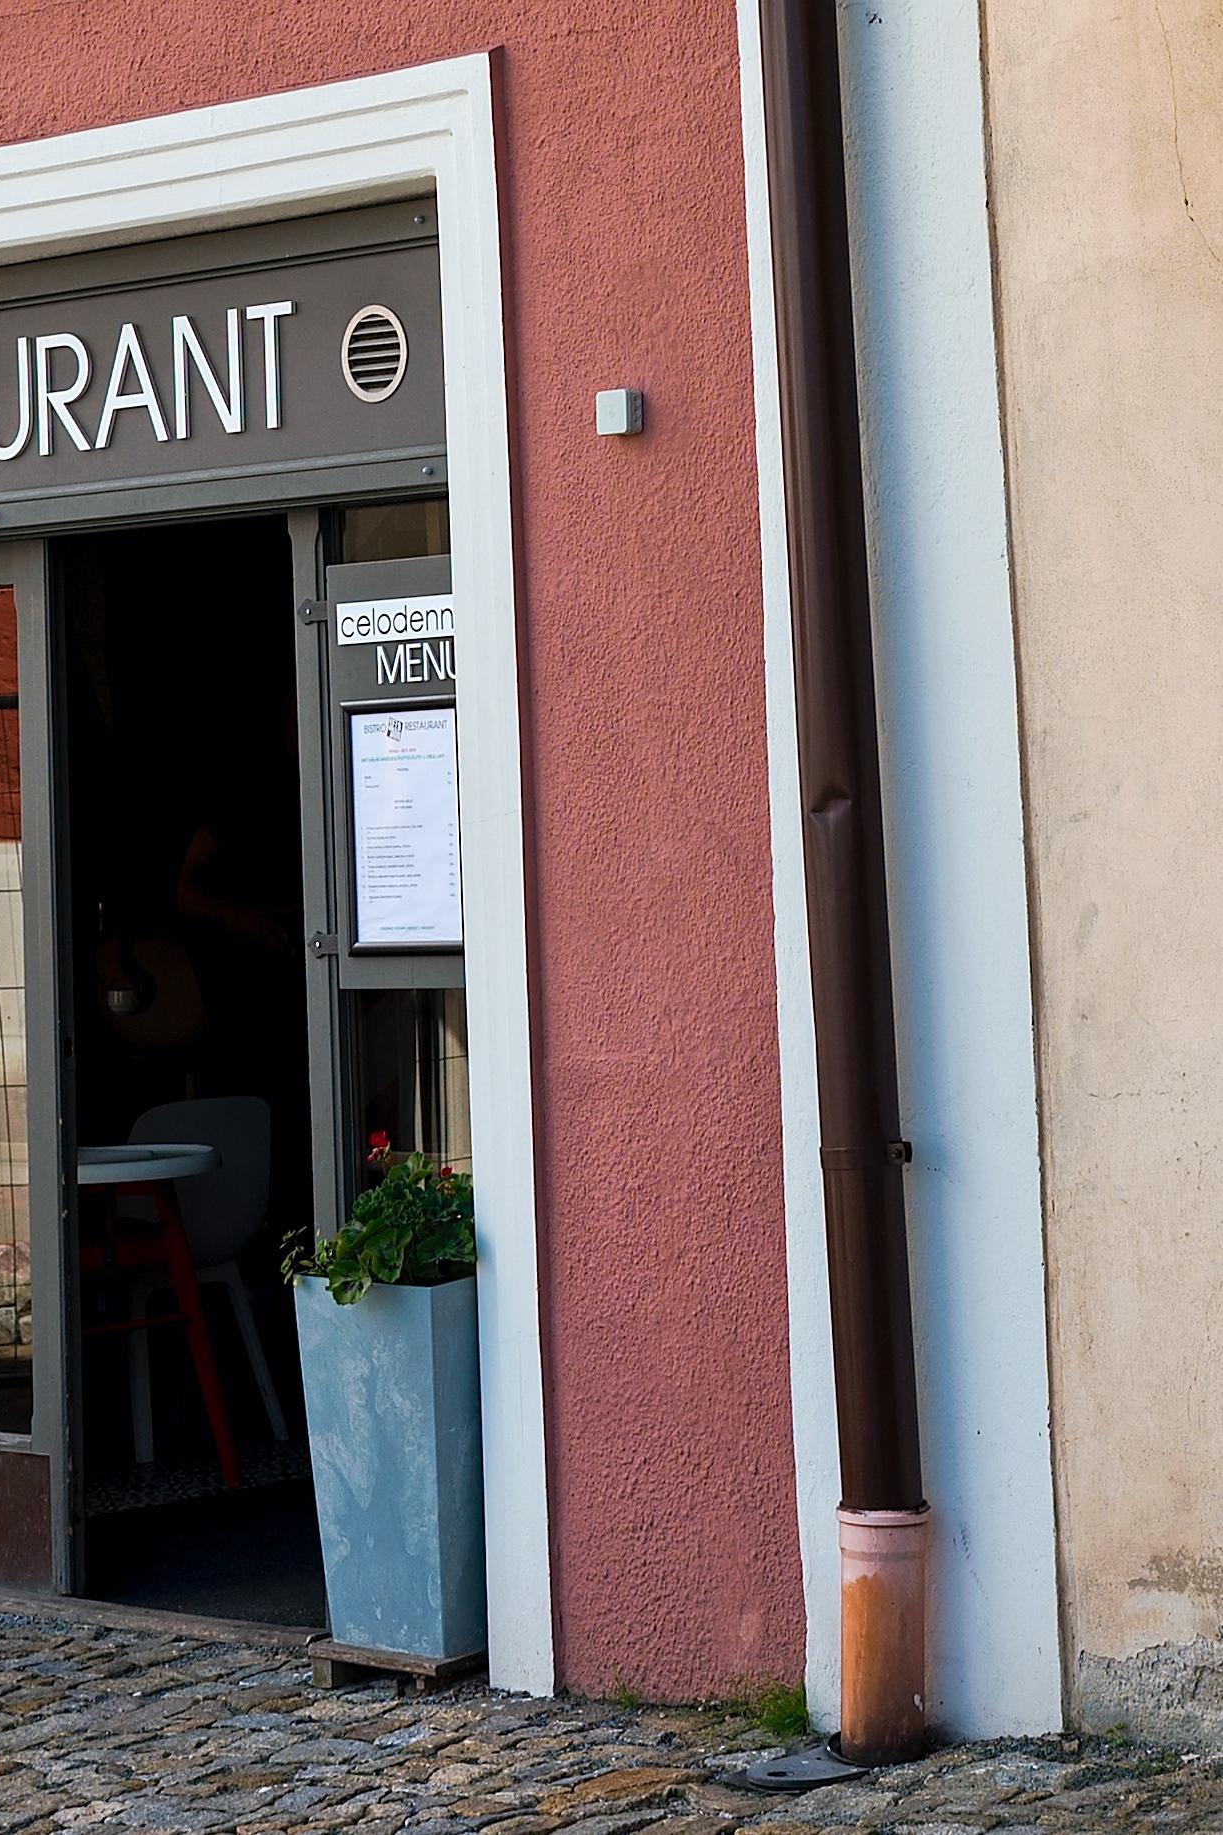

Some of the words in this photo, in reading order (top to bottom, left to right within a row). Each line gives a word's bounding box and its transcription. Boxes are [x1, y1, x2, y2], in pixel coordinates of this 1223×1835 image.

[341, 604, 454, 638] celodenn
[363, 723, 387, 734] BISTRO
[404, 719, 448, 731] RESTAURANT
